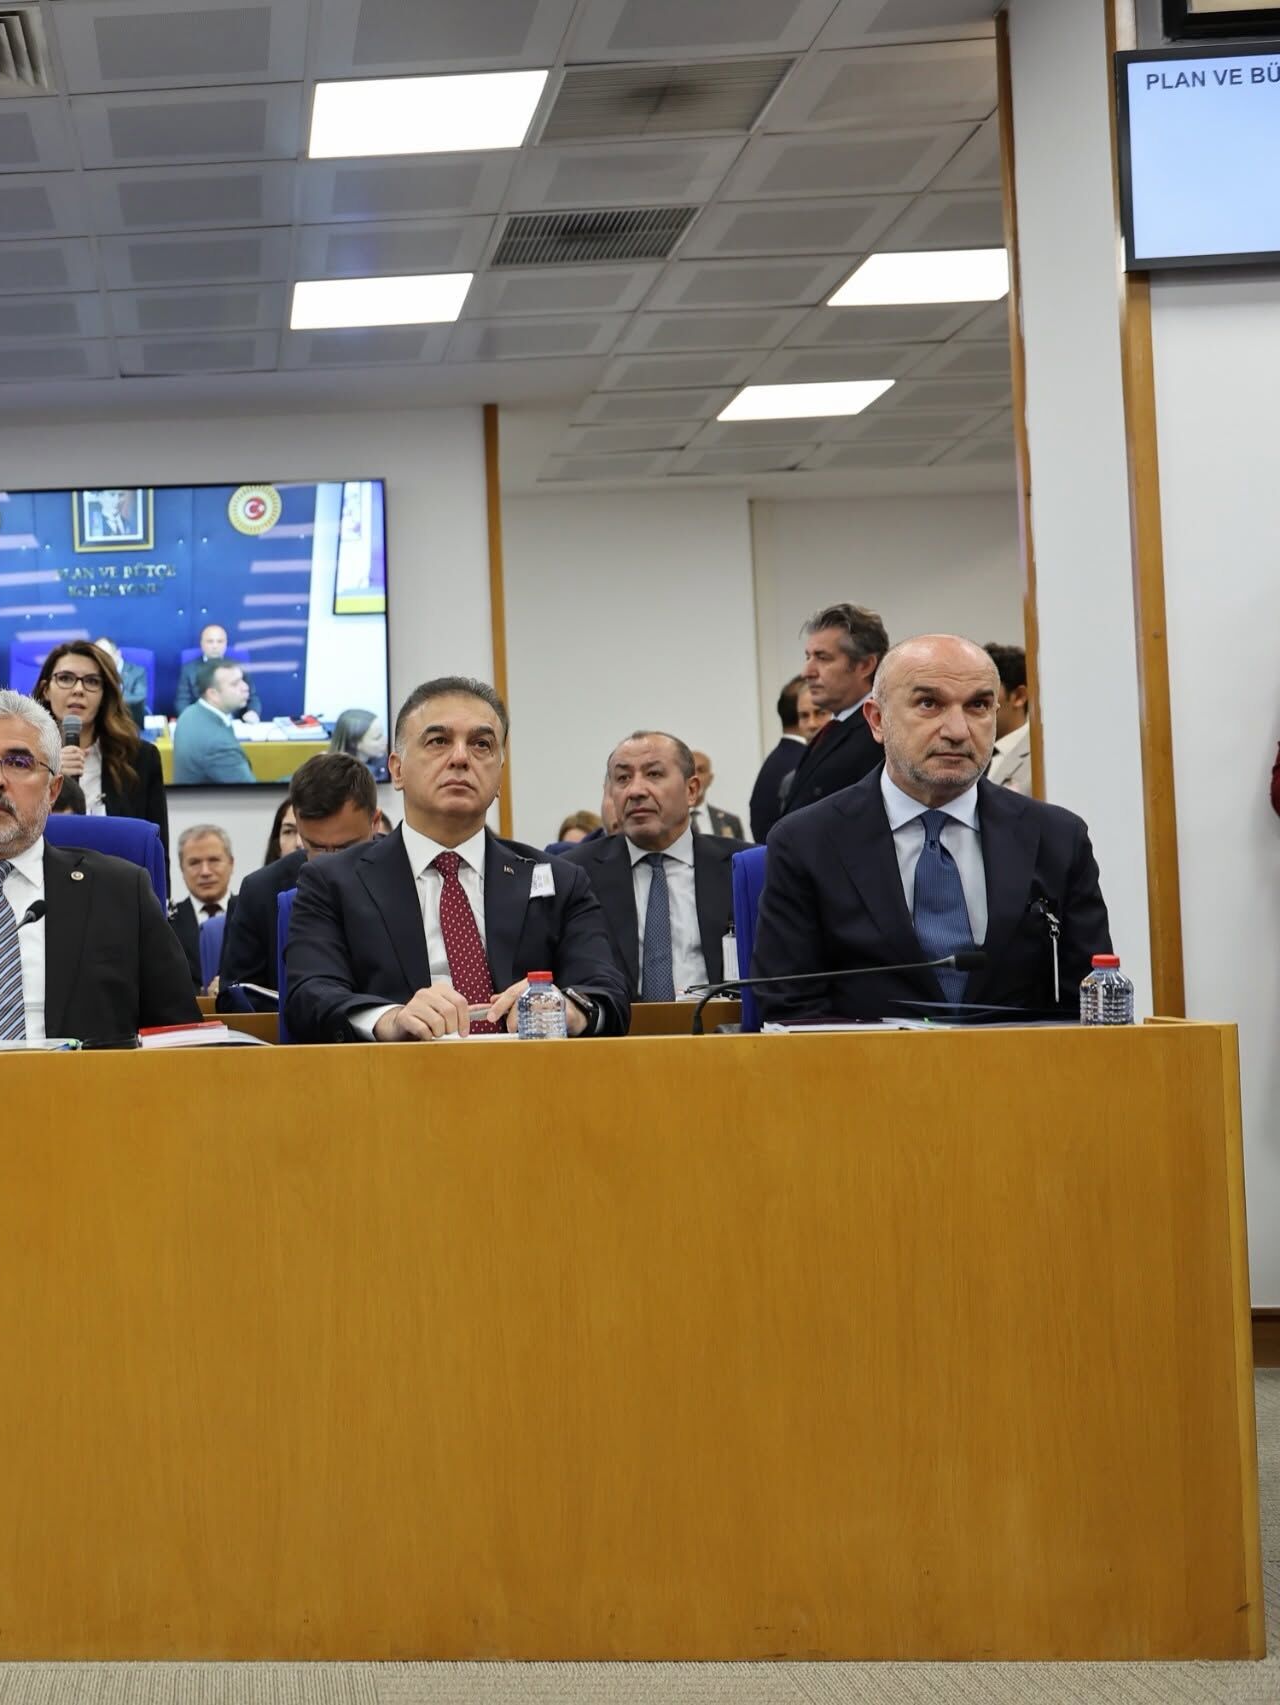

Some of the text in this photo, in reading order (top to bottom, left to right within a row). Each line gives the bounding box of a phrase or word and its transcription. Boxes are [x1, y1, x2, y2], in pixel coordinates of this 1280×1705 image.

[1146, 62, 1280, 90] PLAN VE BÜ
